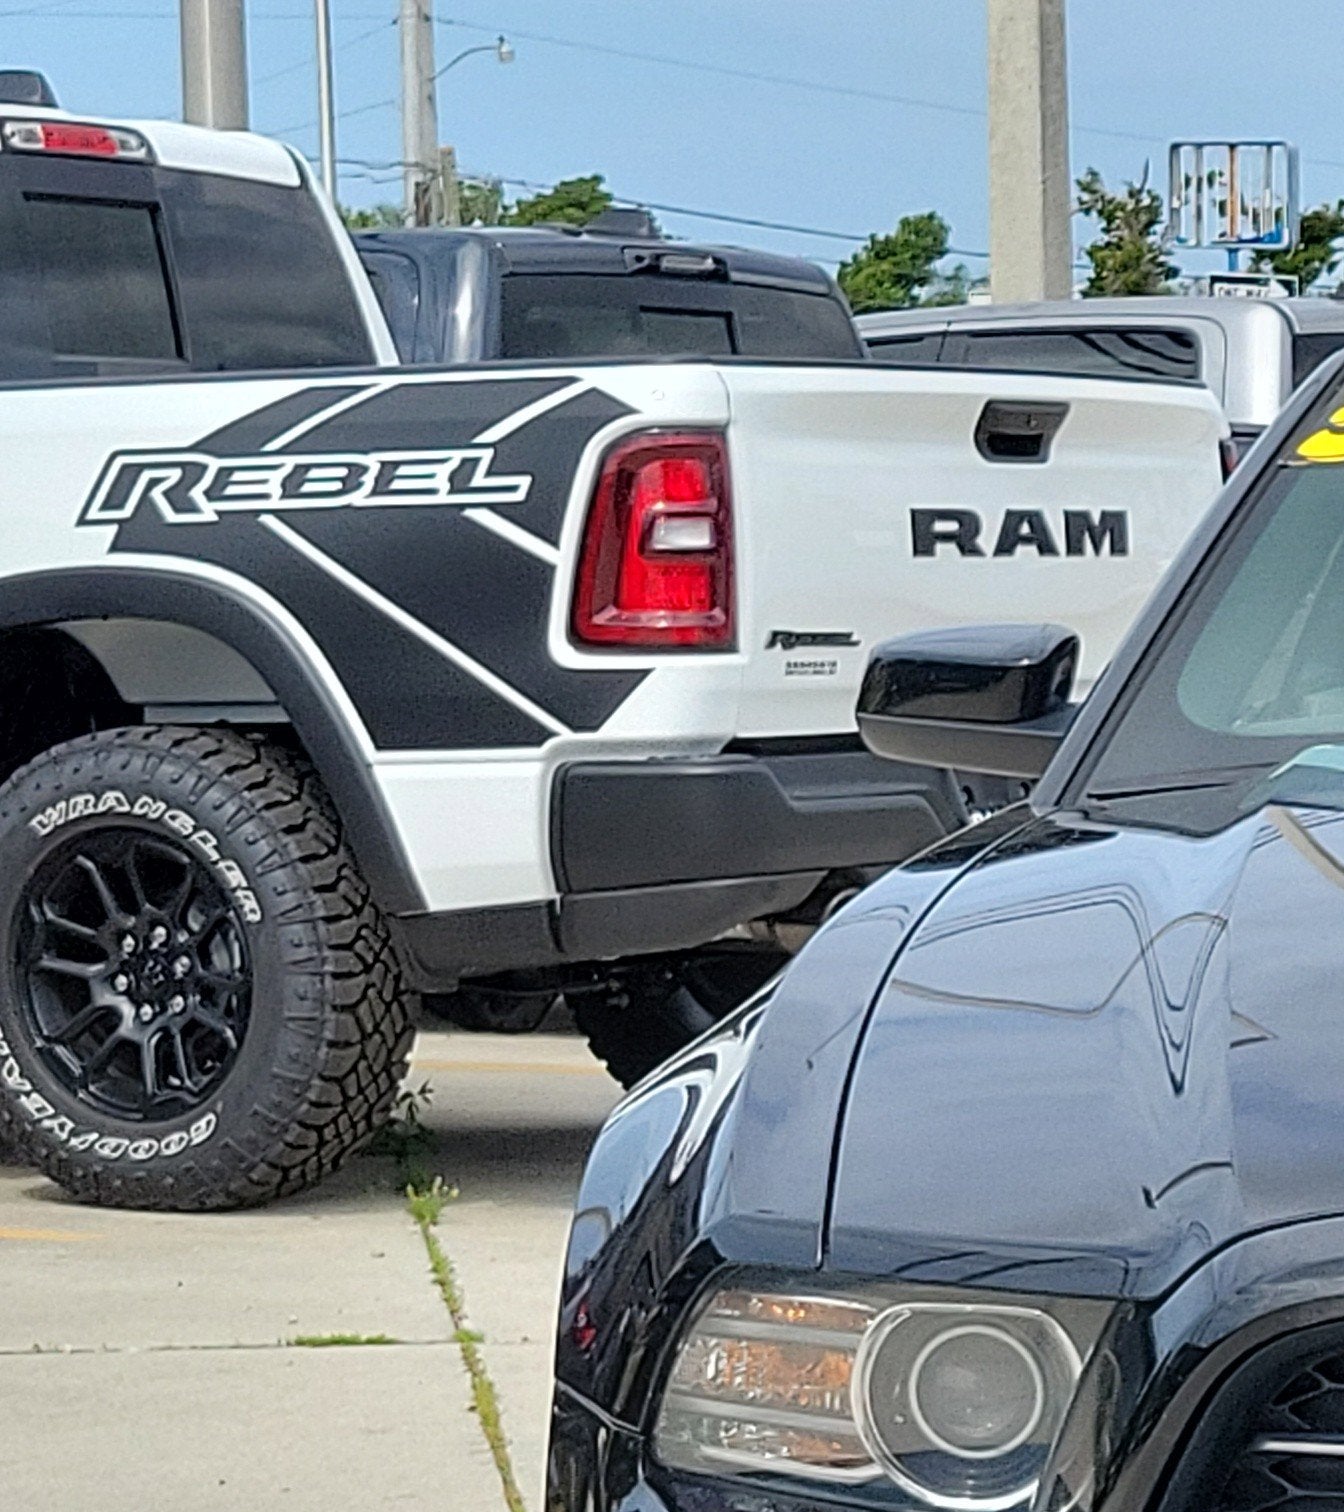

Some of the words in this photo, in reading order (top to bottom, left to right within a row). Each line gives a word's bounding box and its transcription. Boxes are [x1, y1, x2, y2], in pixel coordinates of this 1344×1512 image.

[82, 448, 531, 524] REBEL
[909, 508, 1129, 557] RAM
[29, 791, 262, 924] WRANGLER
